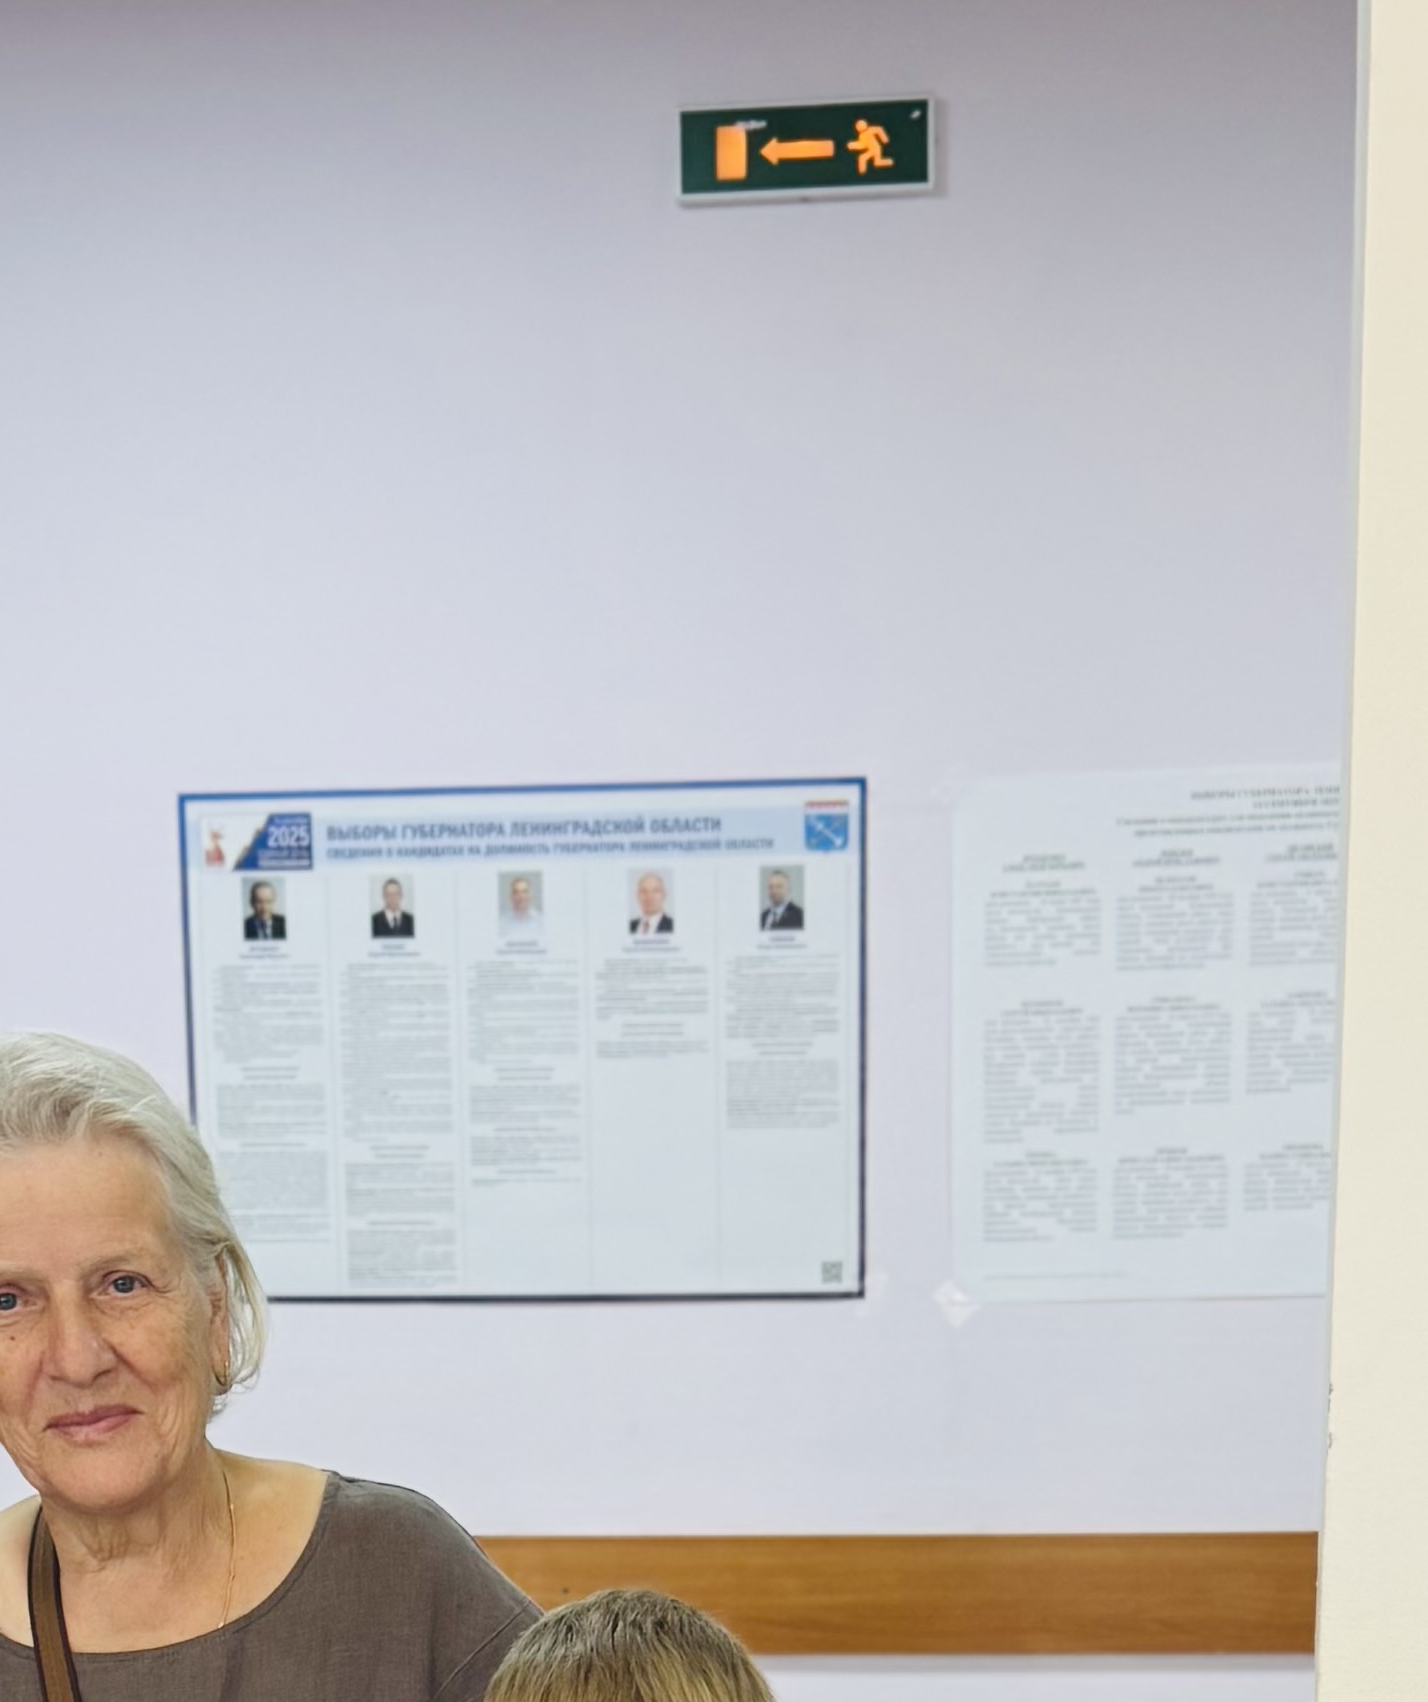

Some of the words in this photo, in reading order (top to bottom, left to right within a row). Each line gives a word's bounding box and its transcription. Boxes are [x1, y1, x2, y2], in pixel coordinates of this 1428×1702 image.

[268, 825, 309, 848] 2025
[326, 824, 397, 841] ВЫБОРЫ
[401, 821, 506, 840] ГУБЕРНАТОРА
[509, 816, 645, 837] ЛЕНИНГРАДСКОЙ
[649, 816, 722, 834] ОБЛАСТИ
